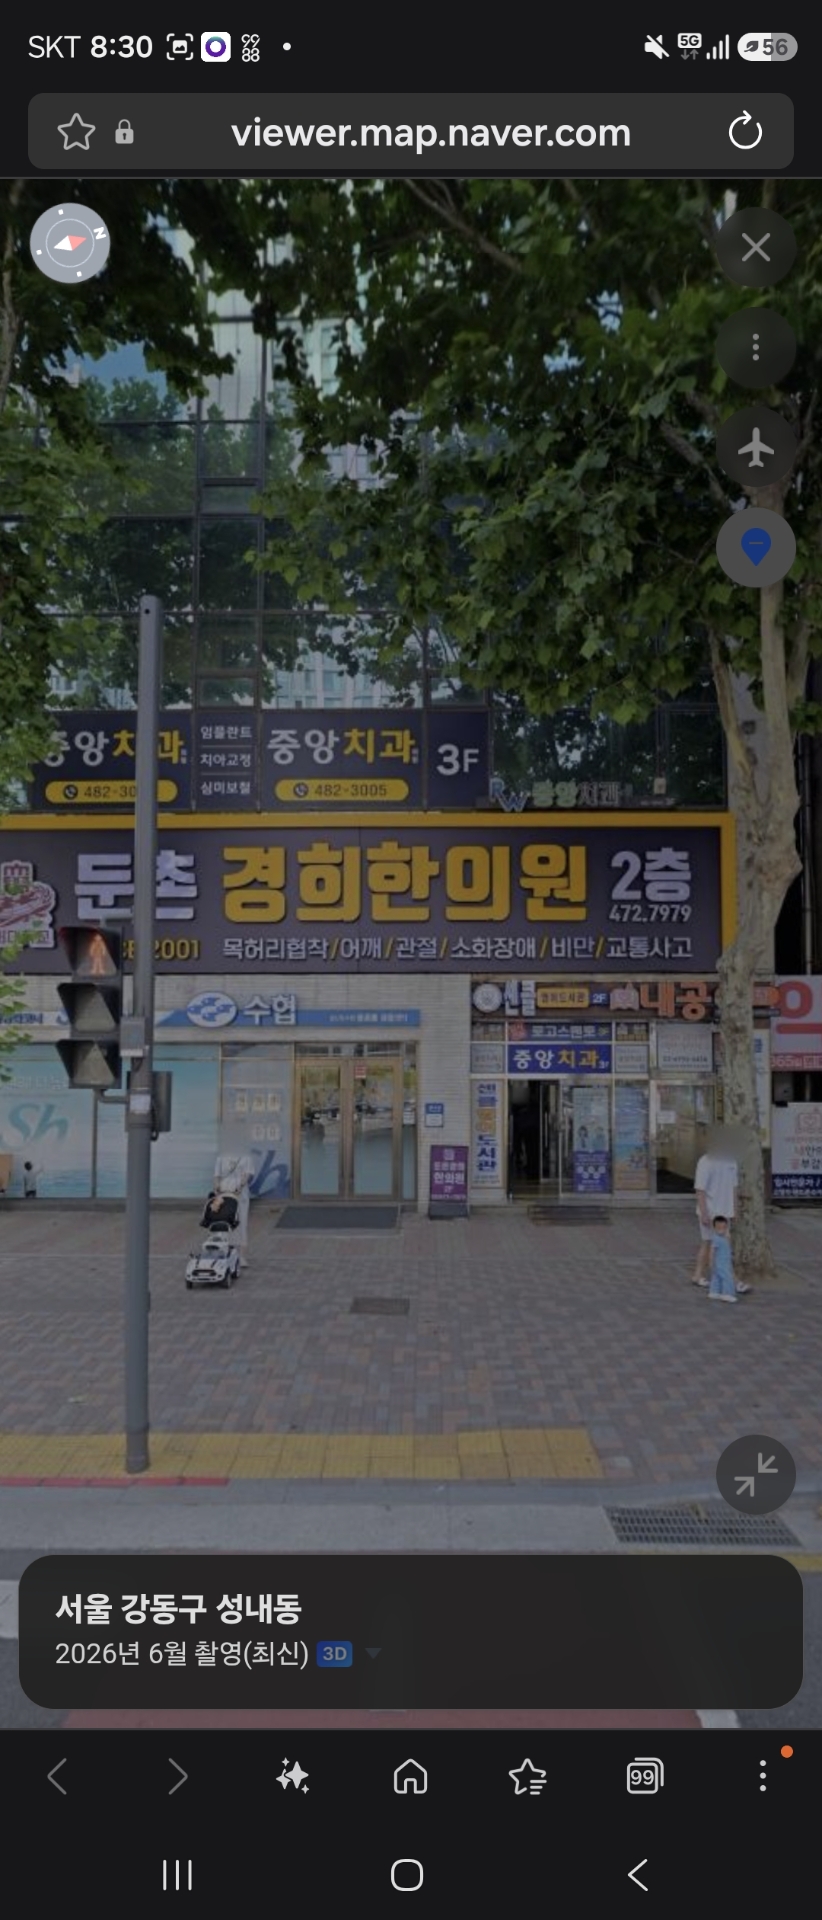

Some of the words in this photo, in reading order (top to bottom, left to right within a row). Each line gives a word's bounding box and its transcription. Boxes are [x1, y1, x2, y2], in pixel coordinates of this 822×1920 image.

[200, 725, 253, 740] 임플란트
[267, 727, 416, 766] 중앙치과
[200, 752, 253, 768] 치아교정
[436, 744, 480, 776] 3F
[83, 785, 137, 799] 482-30
[200, 781, 252, 796] 심미보철
[314, 783, 388, 797] 482-3005
[531, 779, 622, 808] 중앙치과
[74, 850, 197, 921] 둔촌
[222, 840, 587, 923] 경희한의원
[611, 847, 692, 902] 2층
[608, 904, 692, 924] 472.7979
[243, 993, 297, 1026] 수협
[513, 1050, 599, 1069] 중앙치과
[433, 1172, 466, 1185] 한의원
